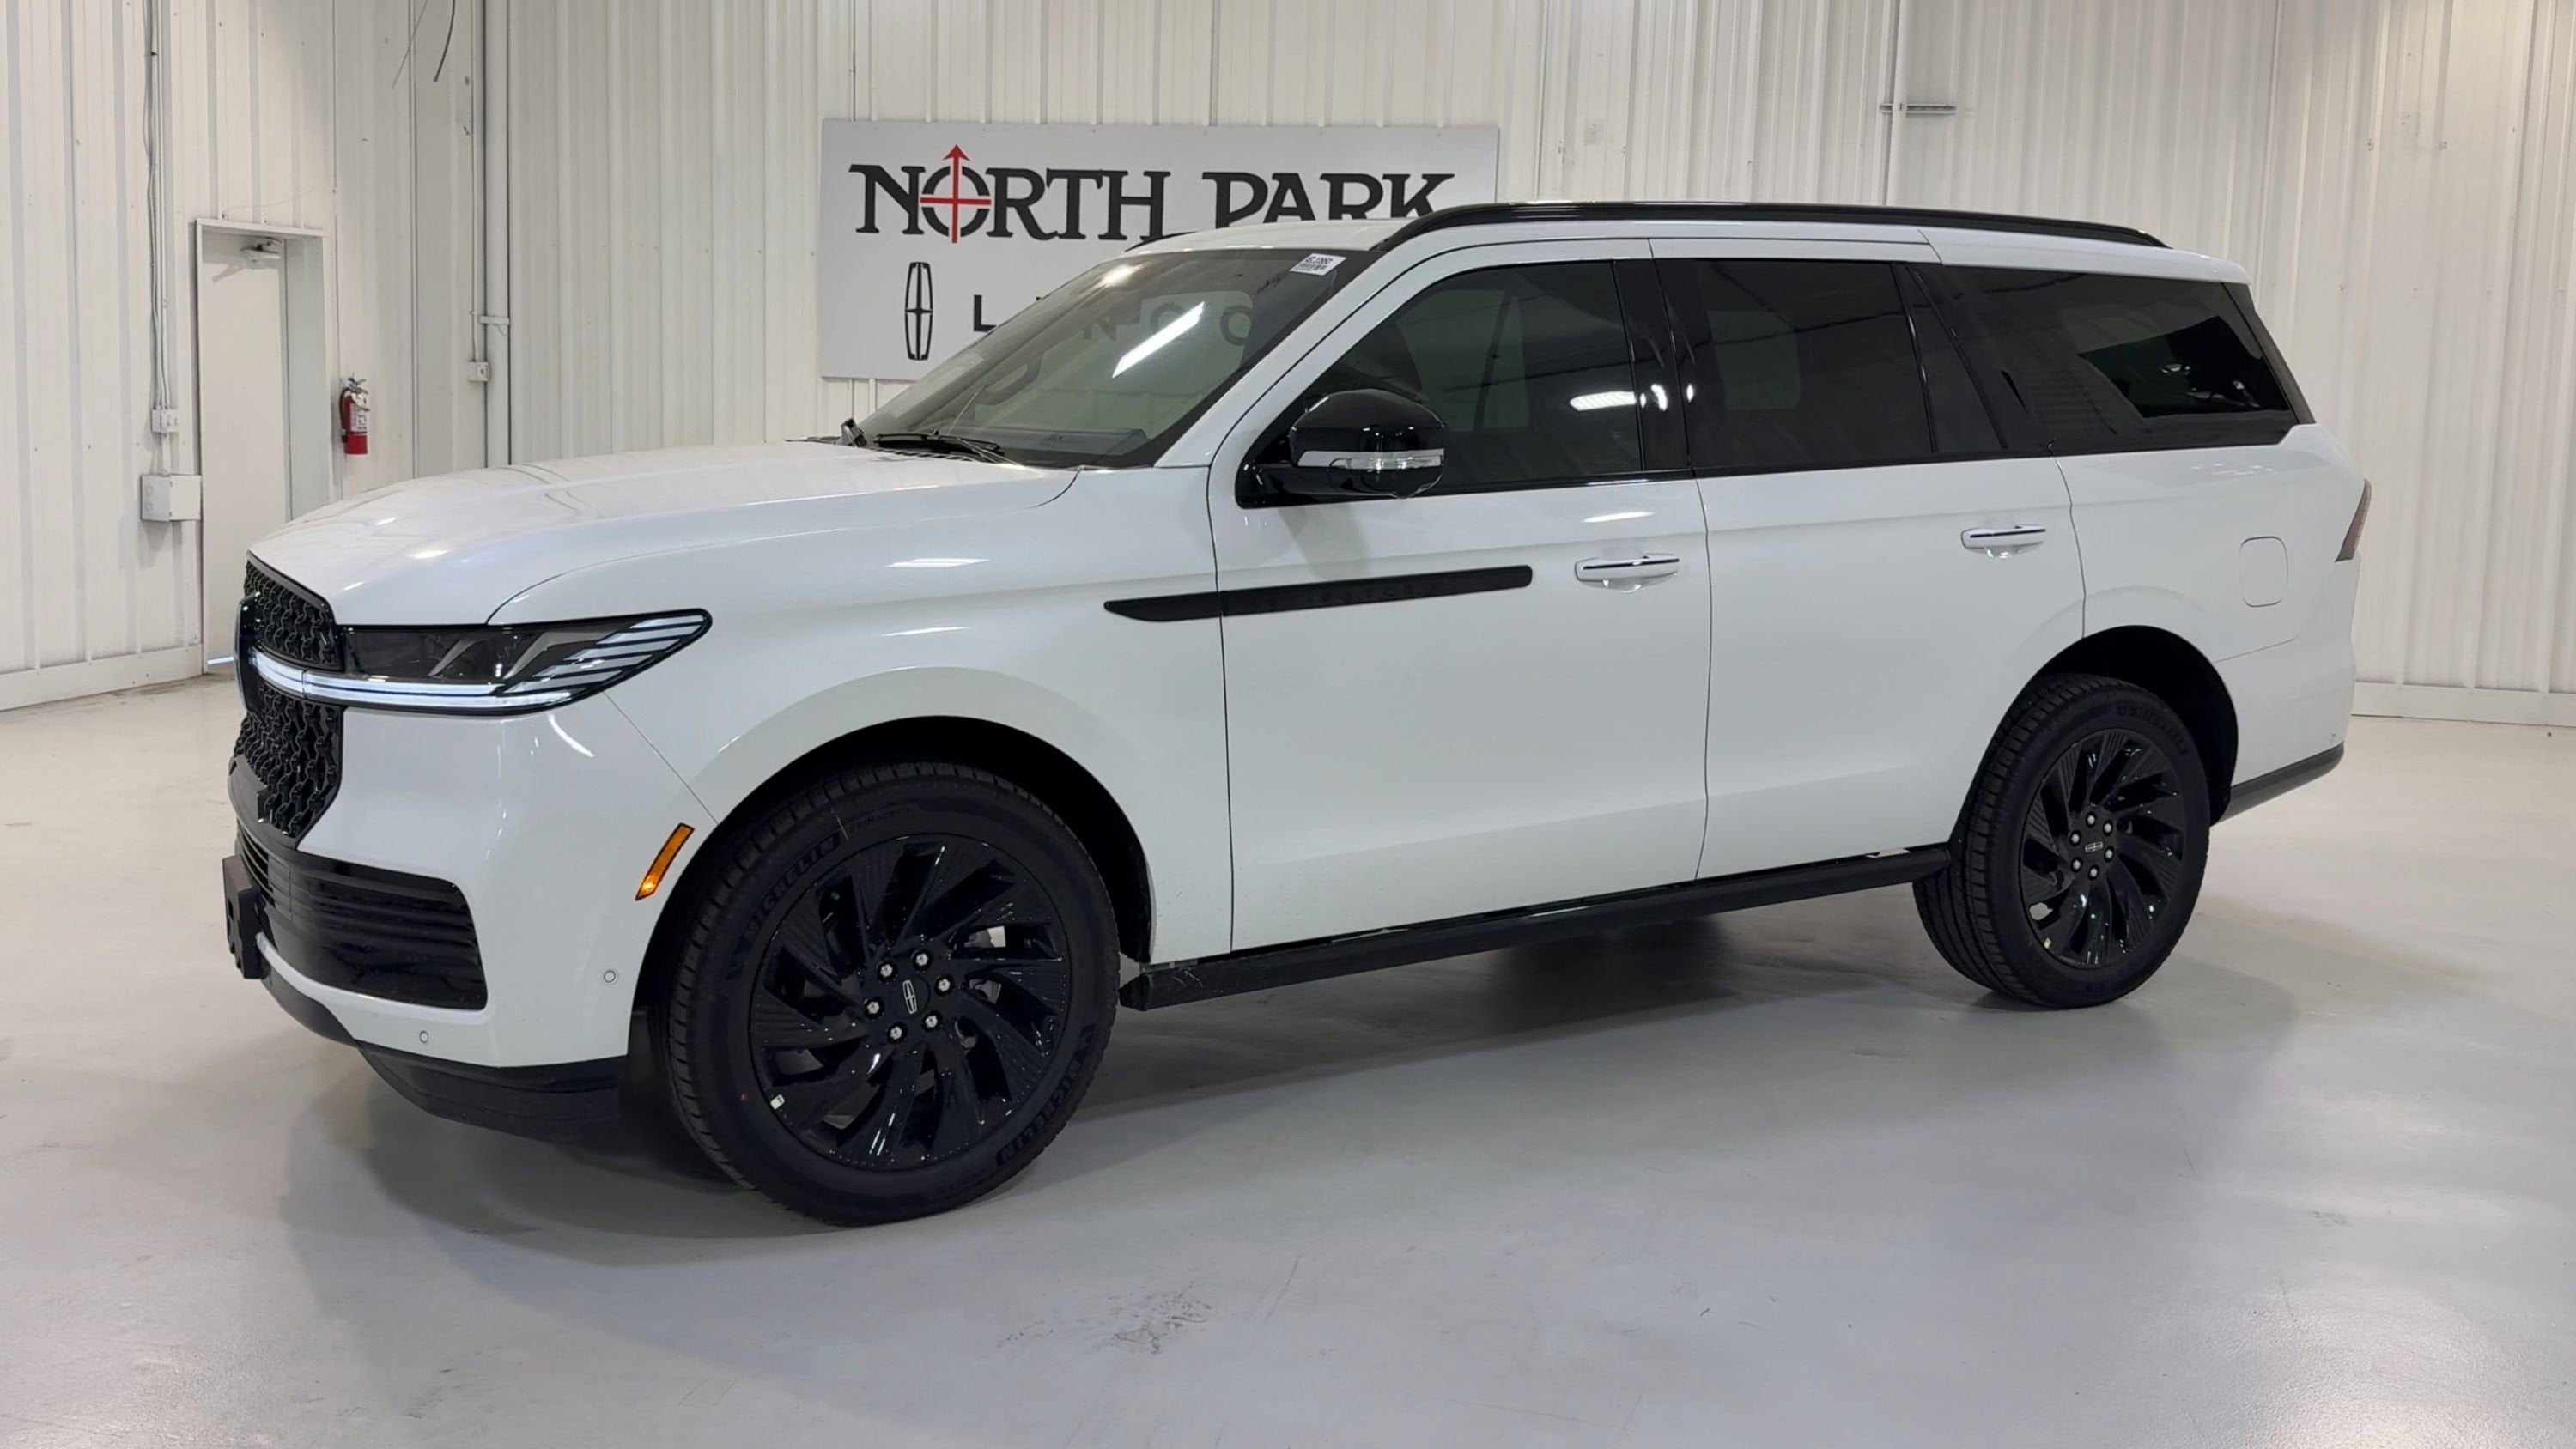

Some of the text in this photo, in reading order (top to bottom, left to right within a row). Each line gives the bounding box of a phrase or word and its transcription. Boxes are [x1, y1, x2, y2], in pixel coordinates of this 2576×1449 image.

[848, 163, 1455, 241] NORTH PARK
[743, 835, 836, 943] MICHELIN
[1000, 1058, 1082, 1163] MICHELIN
